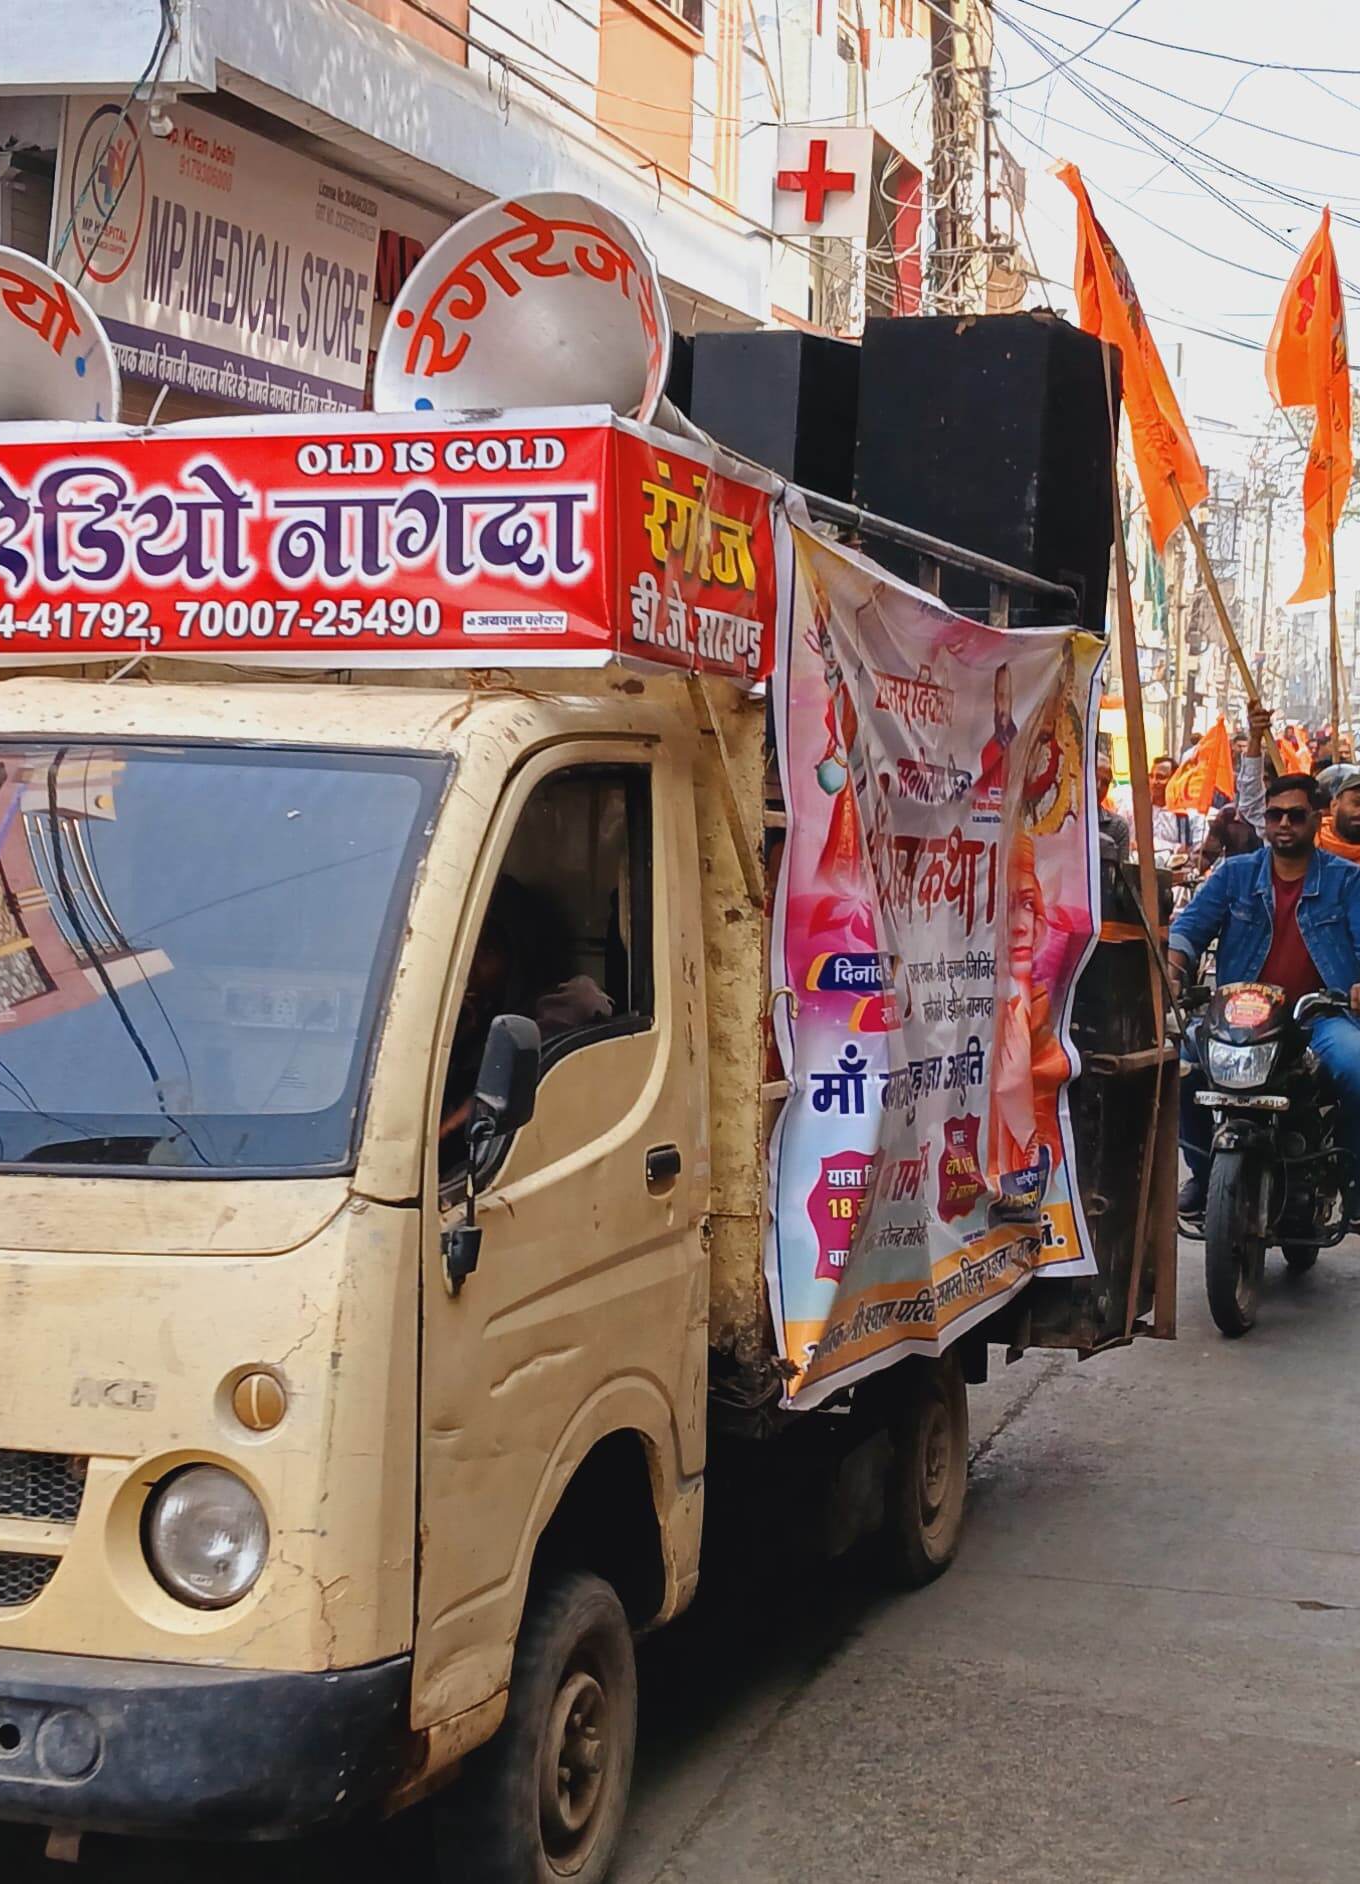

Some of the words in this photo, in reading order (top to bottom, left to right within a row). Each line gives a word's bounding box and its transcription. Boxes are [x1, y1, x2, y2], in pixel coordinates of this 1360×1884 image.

[95, 221, 128, 243] HSPITAL
[143, 196, 290, 343] MP.MEDICAL
[297, 252, 368, 365] STORE
[397, 201, 638, 378] रंगरेज
[159, 343, 188, 385] तेजाजी
[187, 361, 218, 393] महाराज
[218, 360, 239, 398] मंदिर
[297, 444, 379, 475] OLD
[390, 443, 436, 473] IS
[445, 440, 566, 472] GOLD
[276, 492, 589, 584] नागदा
[642, 460, 757, 592] रंगरेज
[176, 598, 442, 636] 70007-25490
[811, 1044, 868, 1116] माँ
[827, 1170, 863, 1187] यात्रा
[828, 1198, 854, 1218] 18
[896, 1287, 938, 1324] परिव
